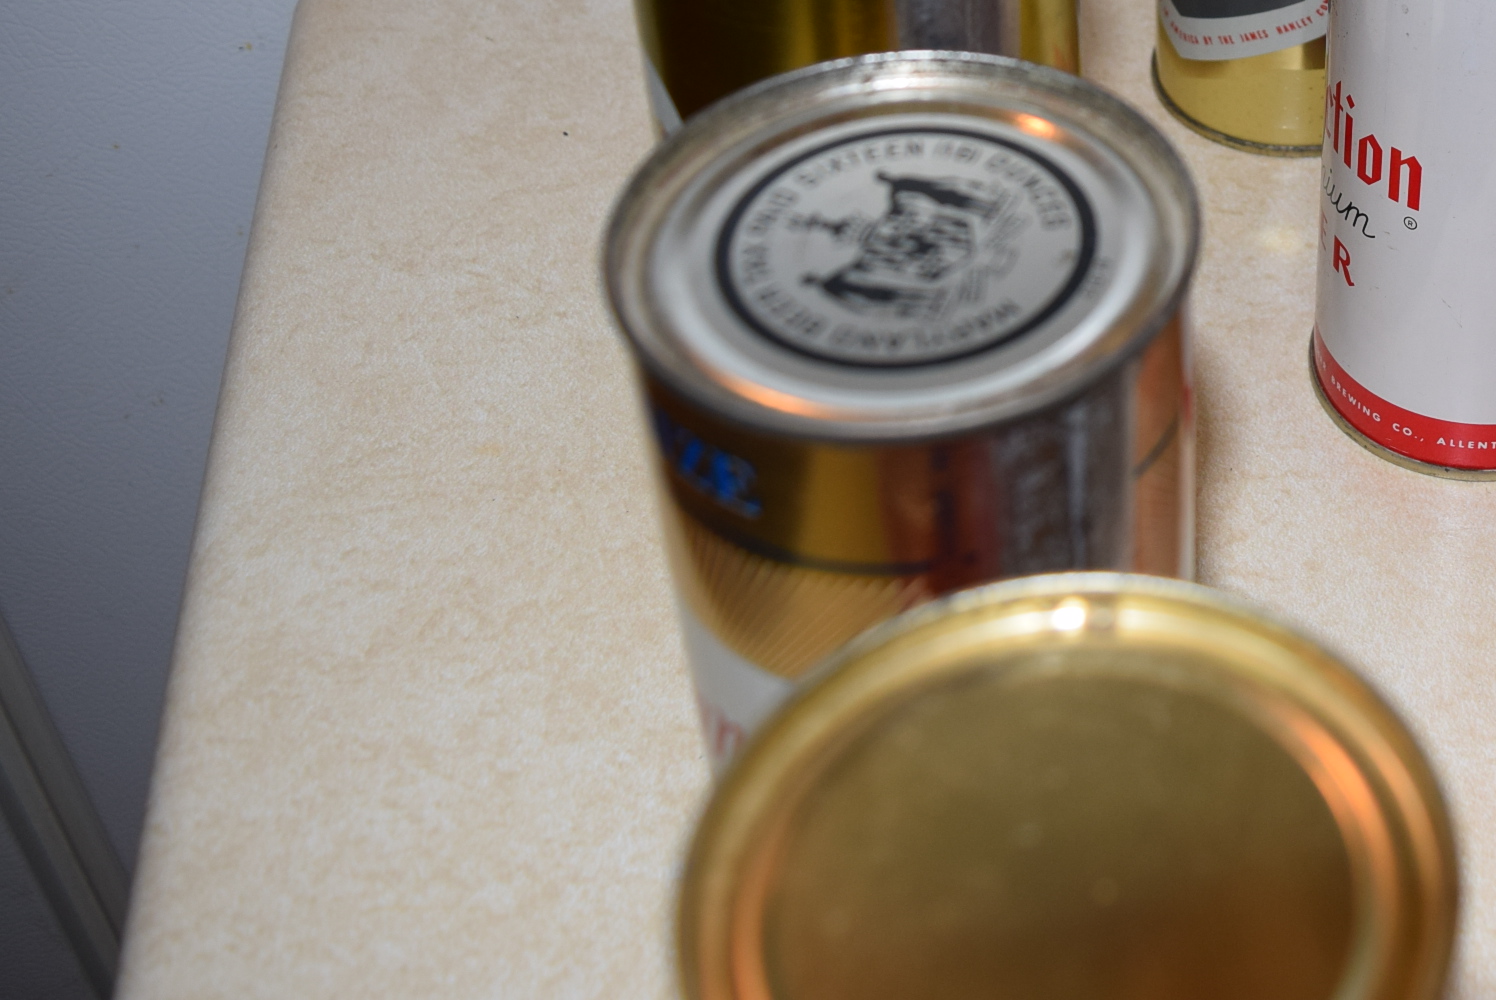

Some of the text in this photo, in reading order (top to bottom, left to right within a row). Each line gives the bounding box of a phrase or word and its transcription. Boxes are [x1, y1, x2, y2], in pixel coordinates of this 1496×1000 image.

[1240, 28, 1269, 43] JAMES
[1275, 15, 1314, 36] HANLEY
[1330, 374, 1381, 422] BREWING
[1392, 422, 1424, 443] CO.,
